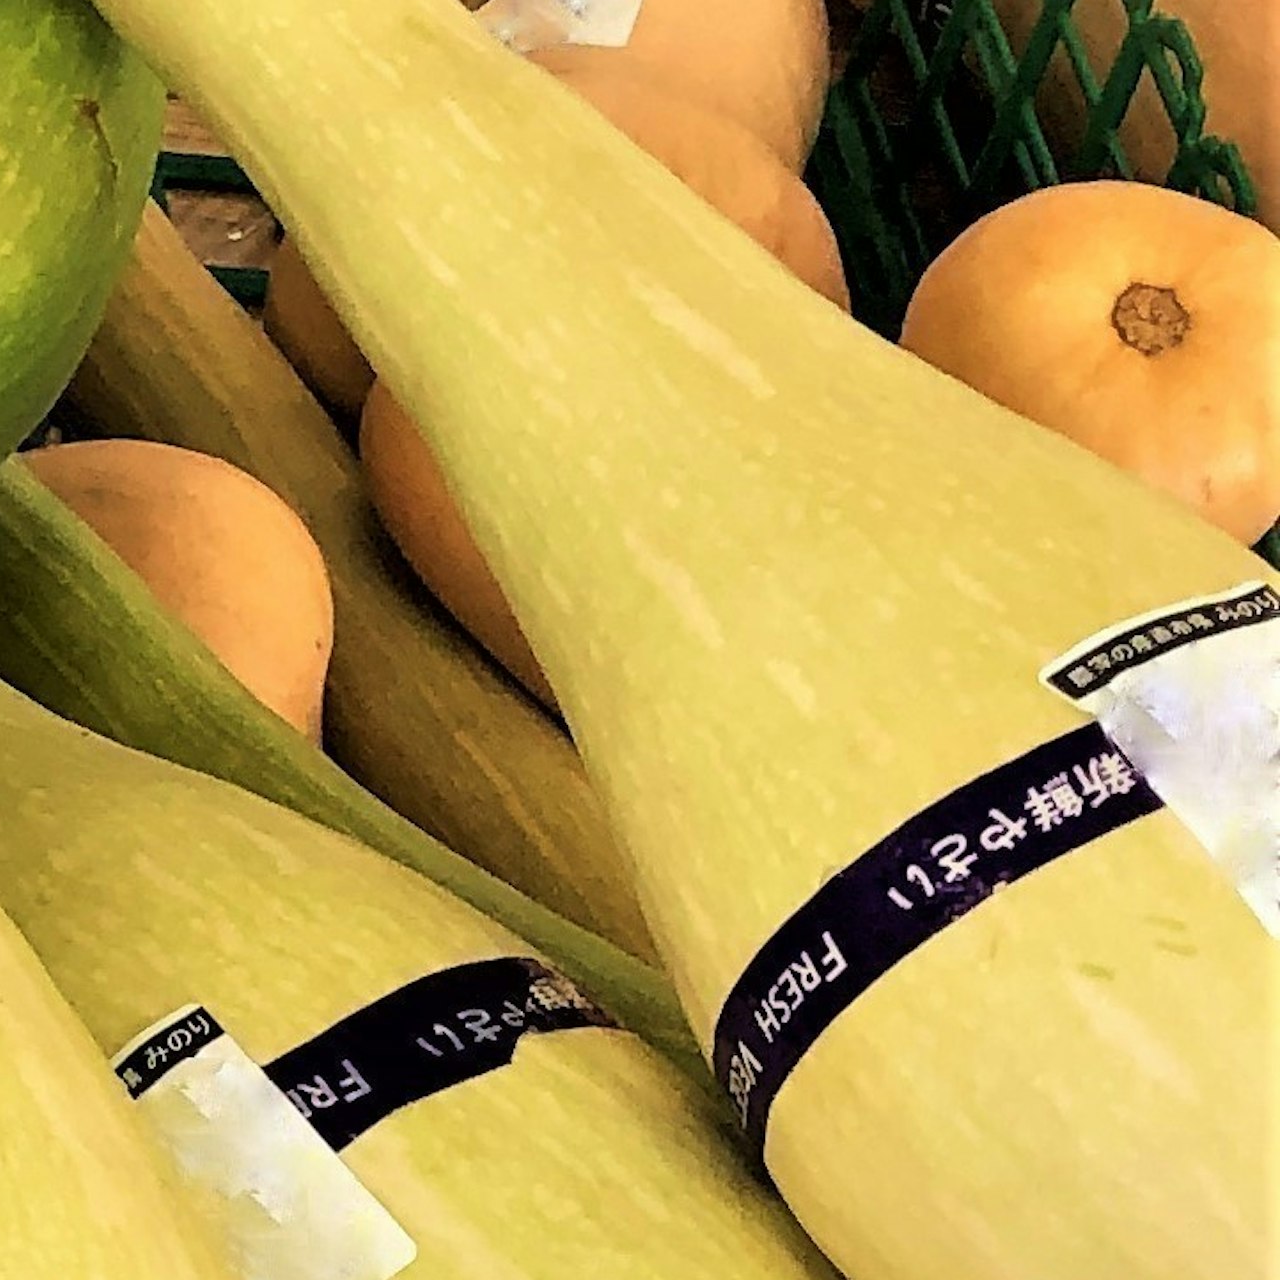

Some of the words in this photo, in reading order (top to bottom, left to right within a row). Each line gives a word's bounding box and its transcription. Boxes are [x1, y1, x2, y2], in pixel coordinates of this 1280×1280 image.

[887, 752, 1138, 911] 新鮮やさい
